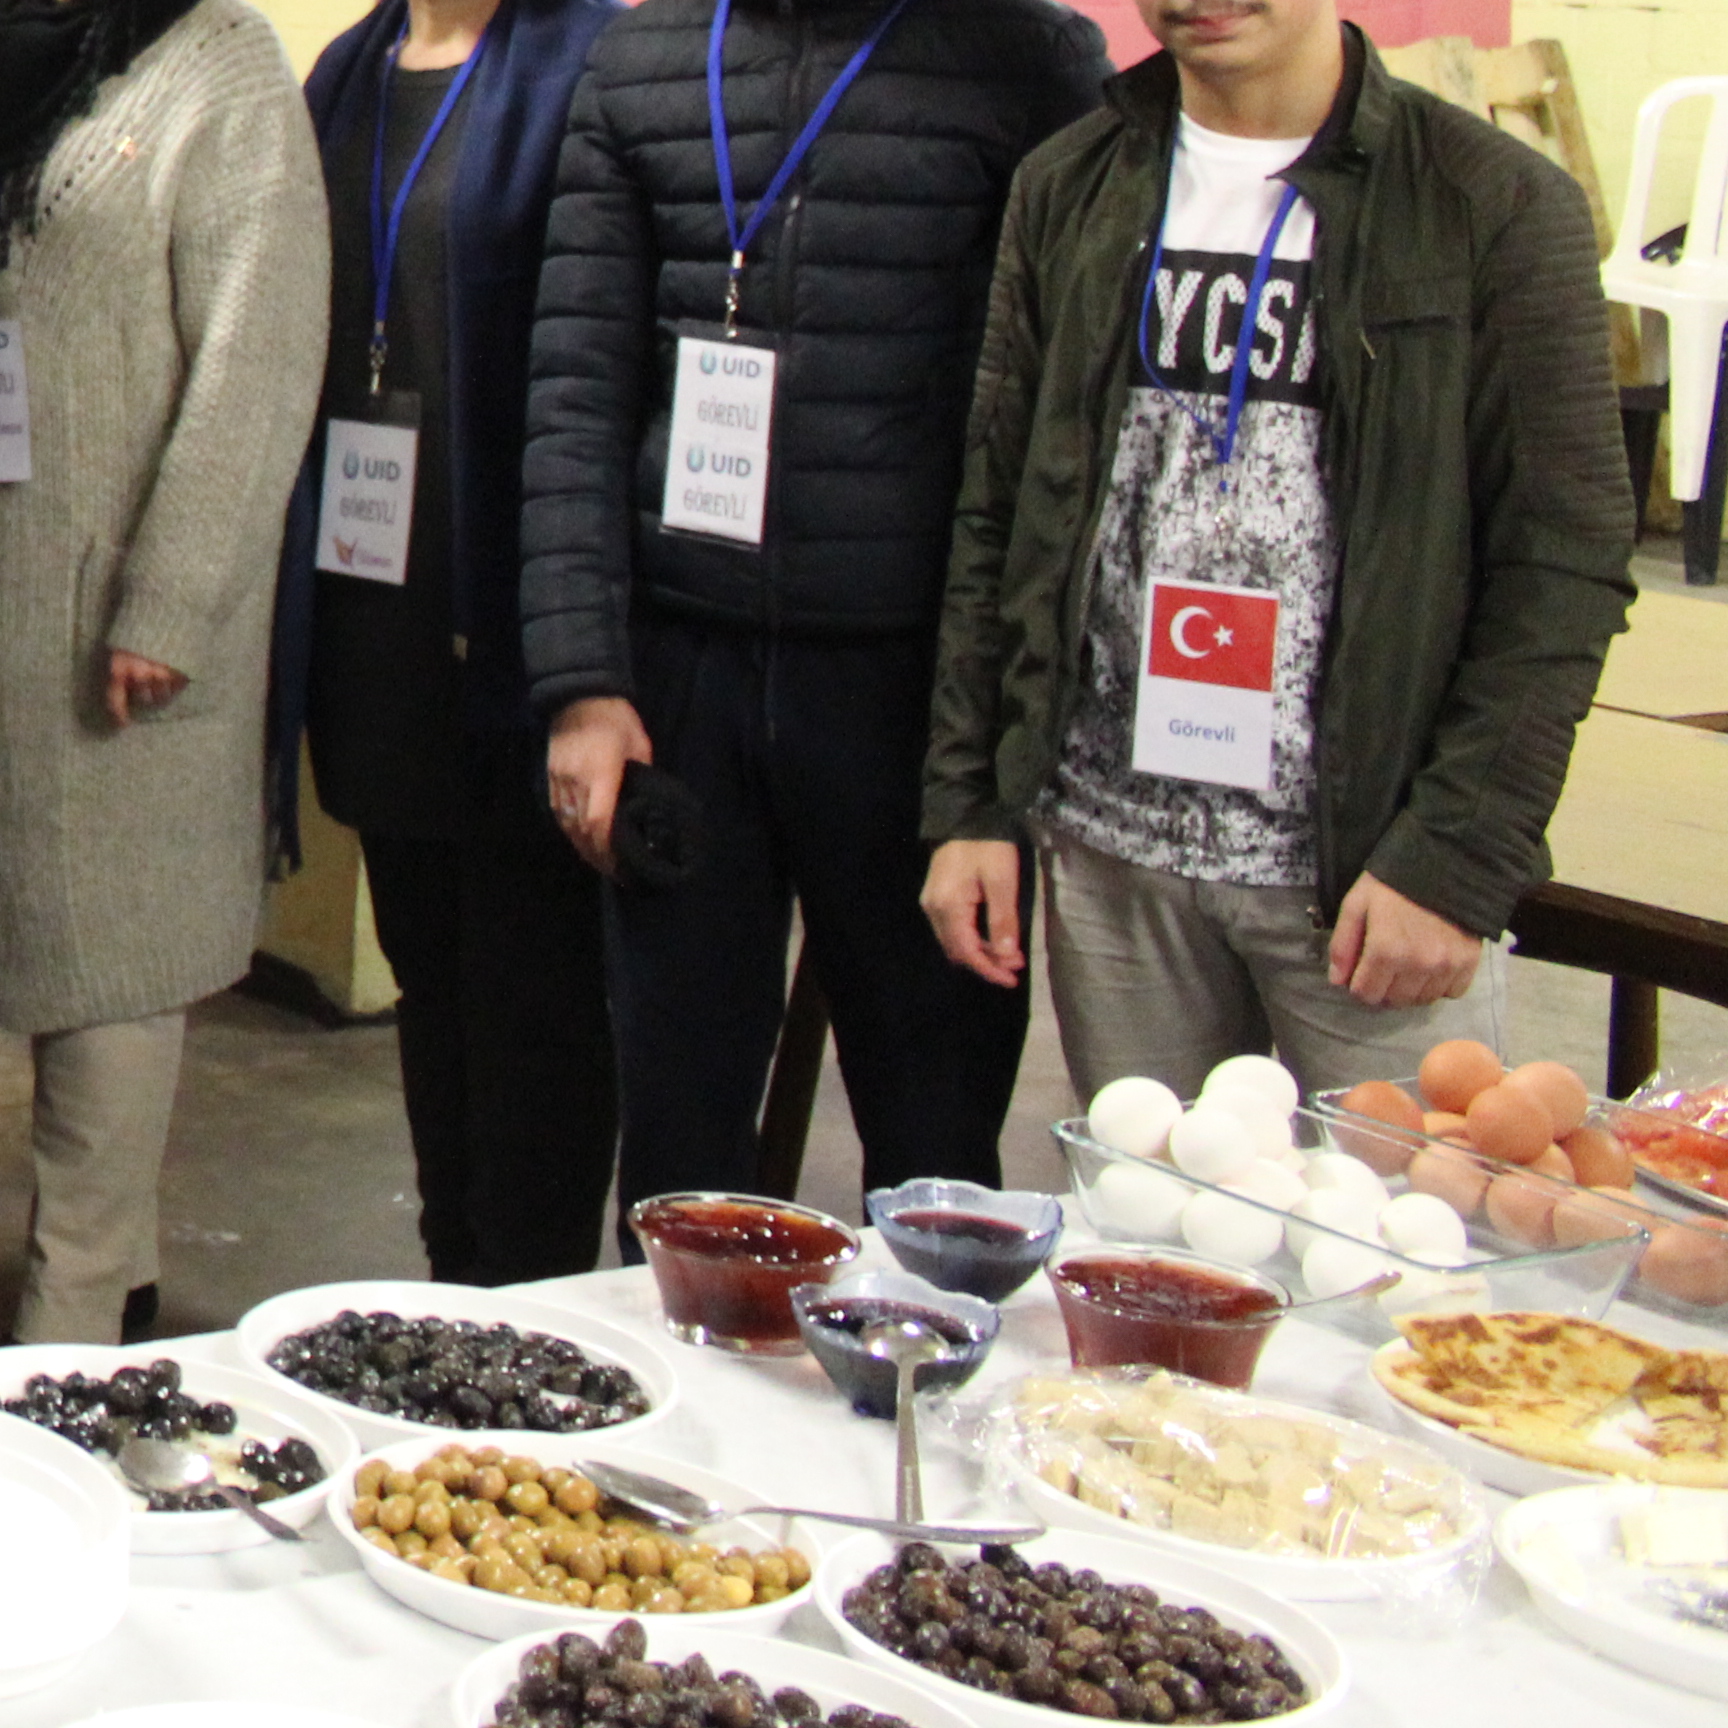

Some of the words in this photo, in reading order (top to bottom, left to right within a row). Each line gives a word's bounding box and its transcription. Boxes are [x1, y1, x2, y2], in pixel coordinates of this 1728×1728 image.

[723, 357, 761, 378] UID
[365, 457, 401, 481] UID
[712, 452, 752, 478] UID
[1169, 718, 1235, 744] Görevli
